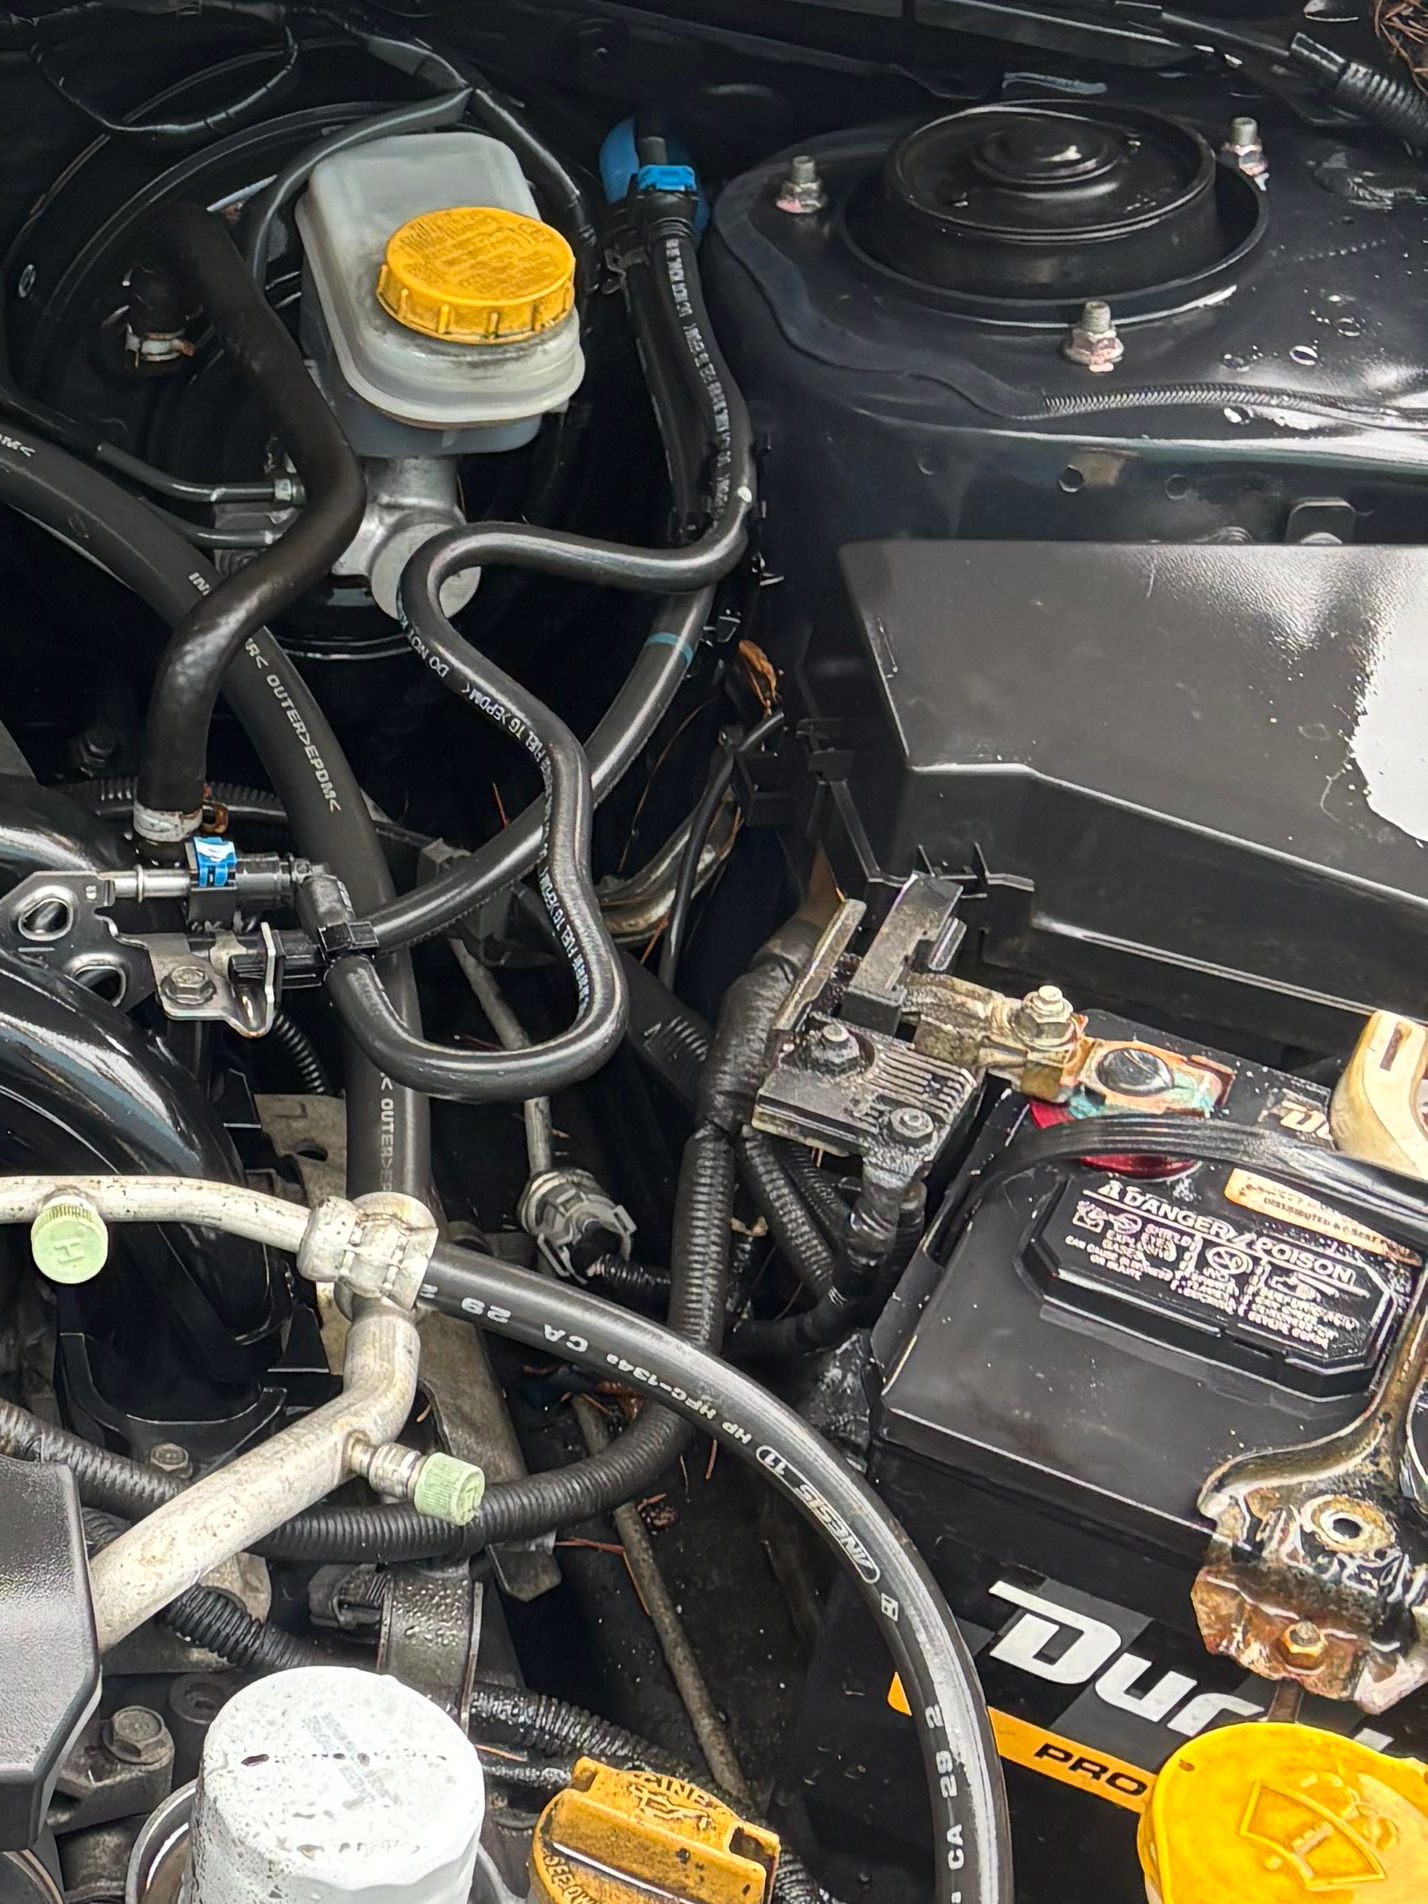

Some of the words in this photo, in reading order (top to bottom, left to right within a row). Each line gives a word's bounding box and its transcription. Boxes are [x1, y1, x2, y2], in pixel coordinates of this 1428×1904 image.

[461, 1295, 512, 1325] 29
[543, 1320, 590, 1353] CA
[605, 1352, 719, 1424] HFC-134a
[721, 1420, 752, 1446] HP
[925, 1704, 945, 1729] 2
[934, 1750, 958, 1800] 29
[946, 1823, 967, 1871] CA
[543, 1850, 569, 1889] SEE
